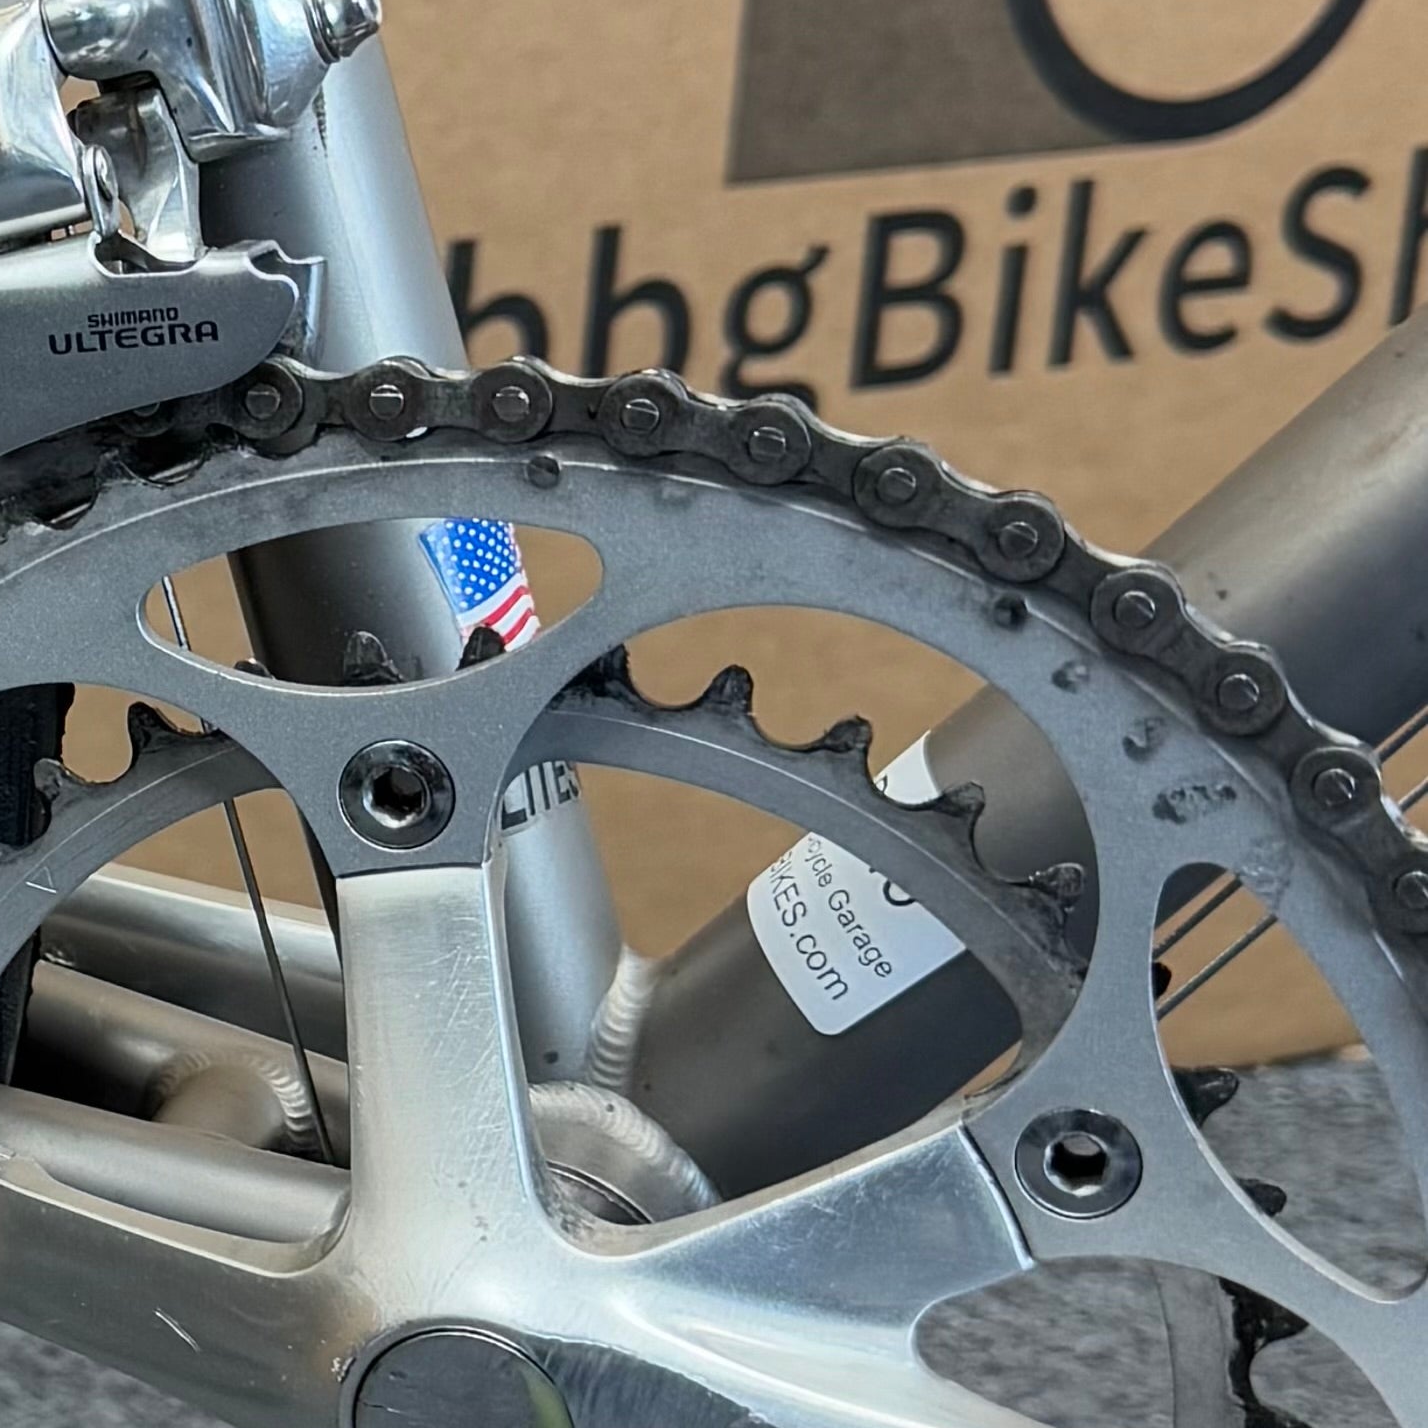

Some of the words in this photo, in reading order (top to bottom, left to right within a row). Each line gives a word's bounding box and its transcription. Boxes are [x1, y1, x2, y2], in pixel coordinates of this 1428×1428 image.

[87, 307, 178, 328] SHIMANO
[48, 320, 219, 355] ULTEGRA
[828, 889, 893, 978] Garage
